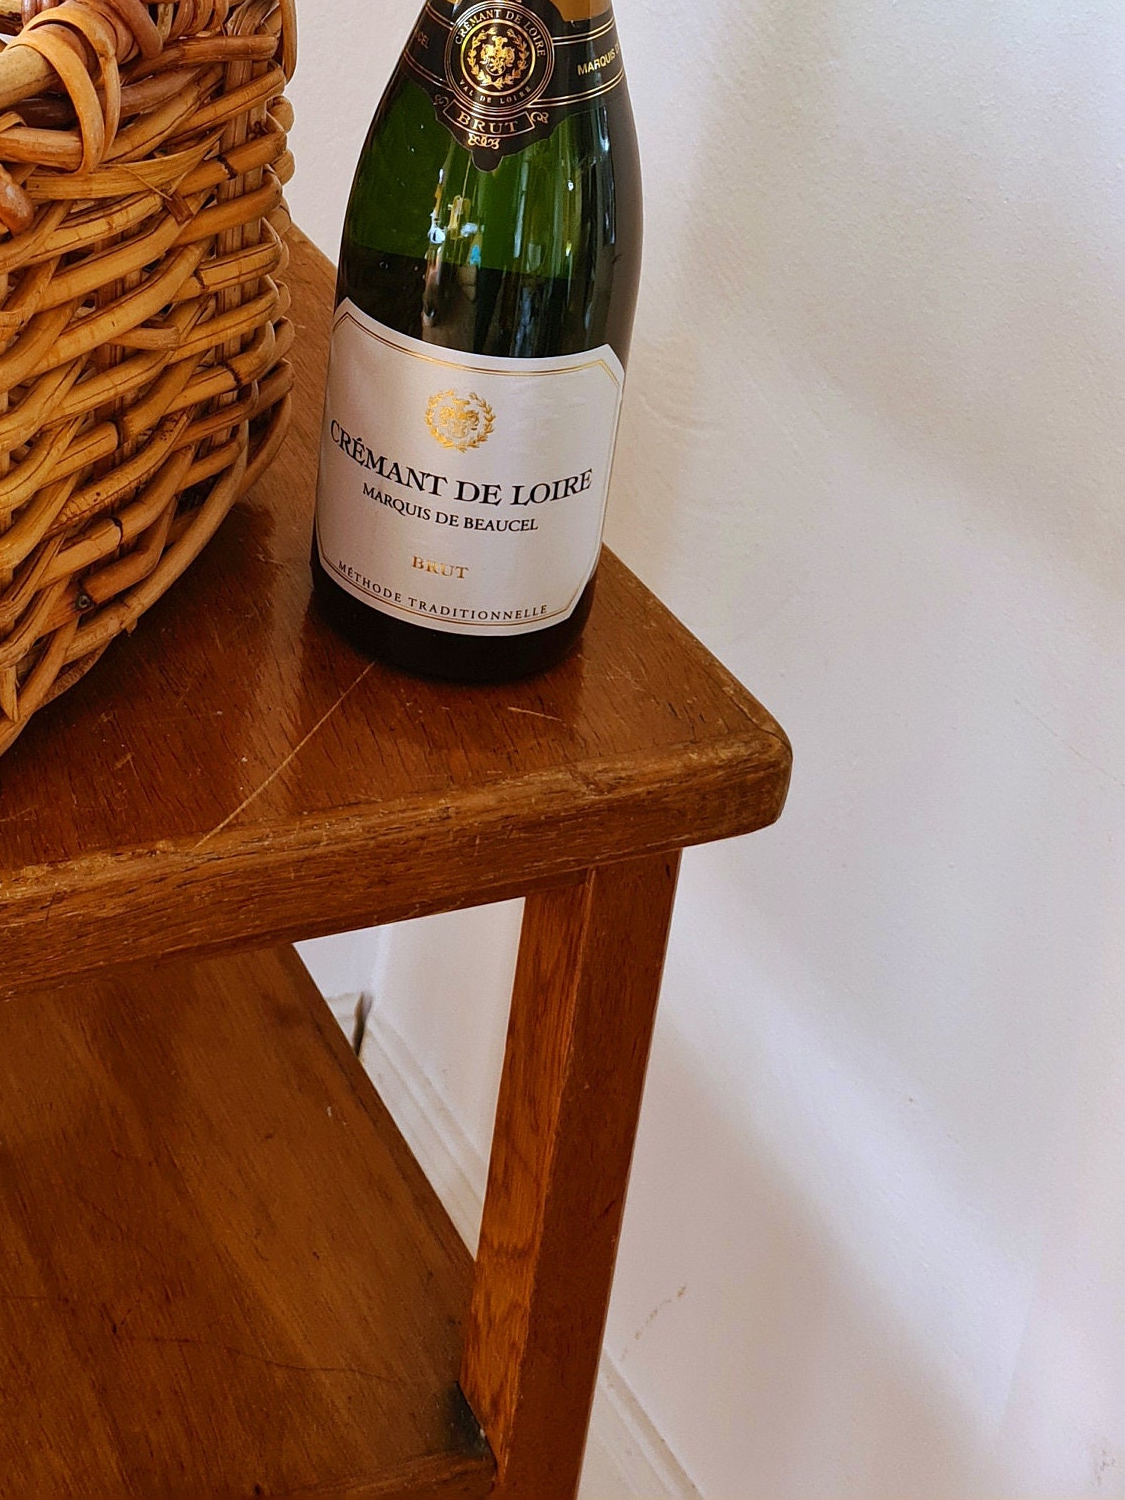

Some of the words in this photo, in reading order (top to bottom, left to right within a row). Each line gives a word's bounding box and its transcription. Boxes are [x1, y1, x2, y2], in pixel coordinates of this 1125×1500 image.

[505, 10, 523, 24] DE
[523, 20, 546, 57] LOIRE
[457, 111, 519, 133] BRUT
[330, 419, 449, 497] CRÉMANT
[454, 480, 502, 506] DE
[510, 468, 594, 507] LOIRE
[362, 482, 431, 521] MARQUIS
[435, 511, 459, 528] DE
[463, 517, 539, 532] BEAUCEL
[338, 560, 402, 604] MÉTHODE
[408, 596, 548, 621] TRADITIONNELLE
[411, 555, 469, 580] BRUT
